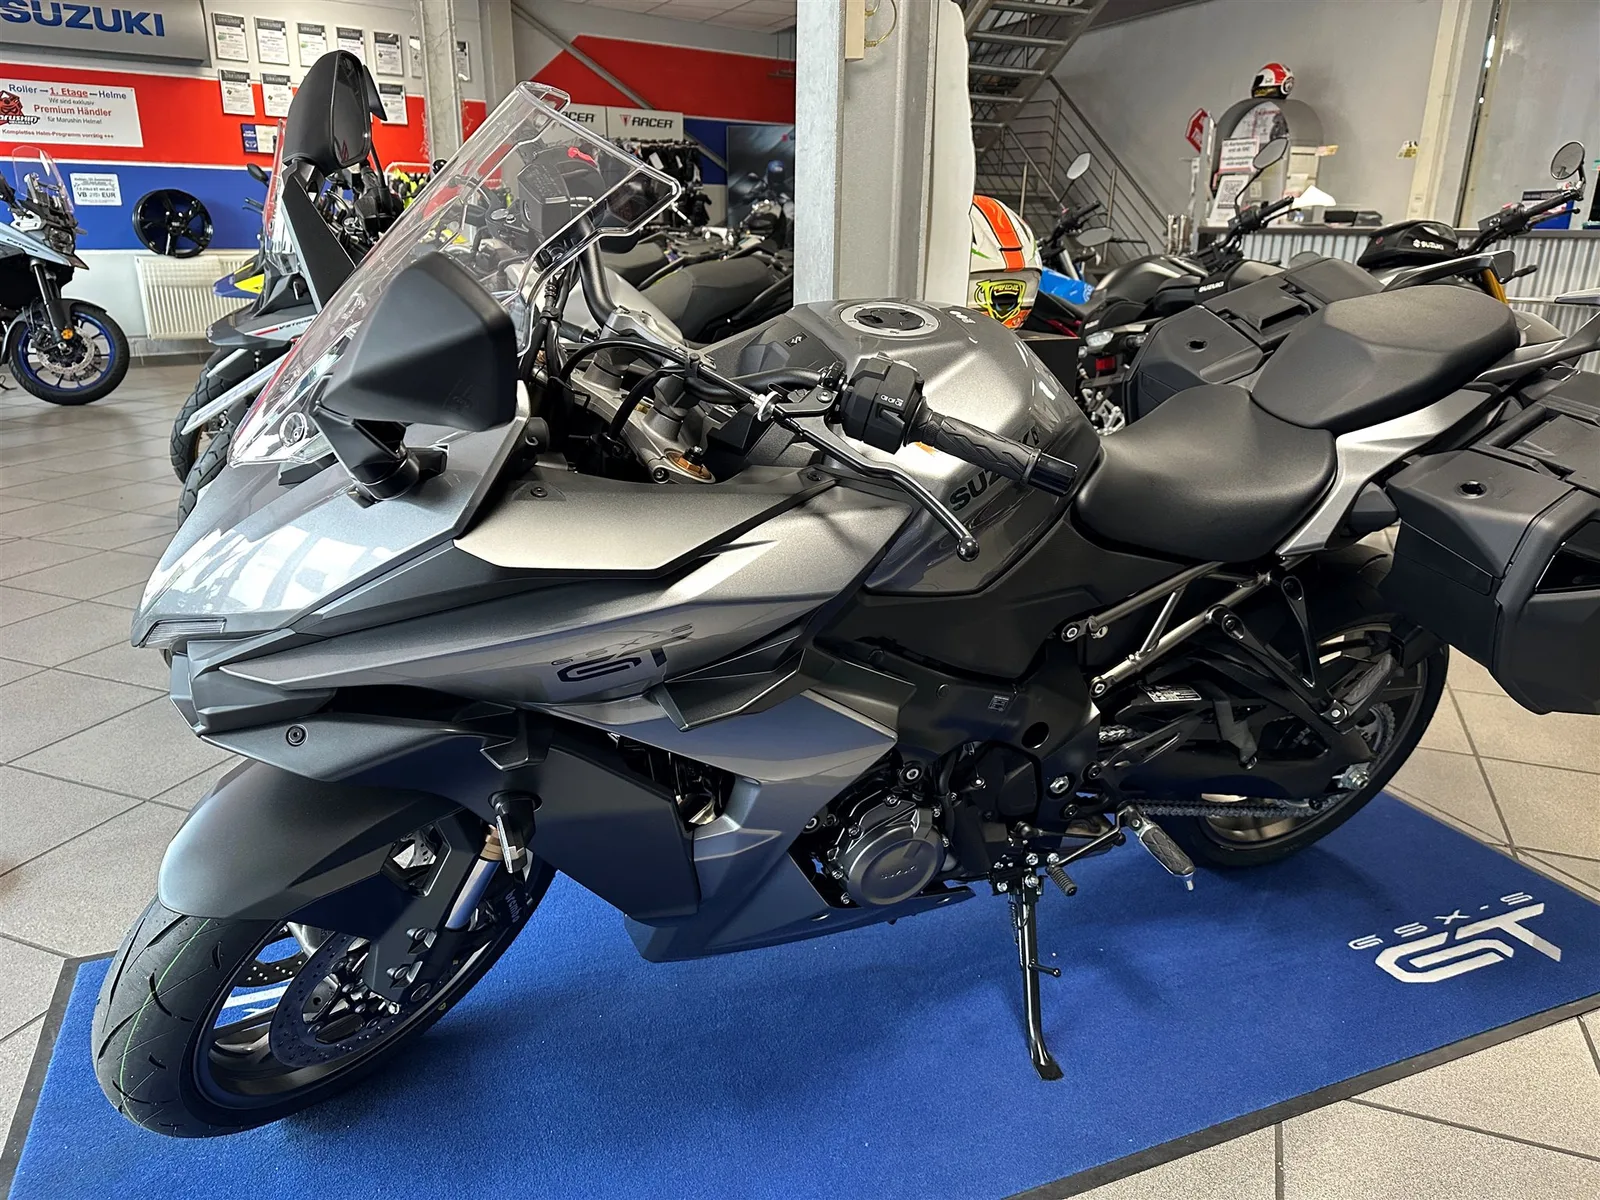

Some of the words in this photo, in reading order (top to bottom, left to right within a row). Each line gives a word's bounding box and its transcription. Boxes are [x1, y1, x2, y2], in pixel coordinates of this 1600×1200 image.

[0, 0, 165, 37] SUZUKI
[9, 83, 37, 94] Roller
[61, 87, 88, 98] Etage
[98, 90, 127, 100] Helme
[33, 104, 75, 114] Premium
[77, 106, 112, 117] Händler
[561, 111, 595, 123] ACER
[632, 116, 673, 128] RACER
[1348, 891, 1533, 950] GSX-S
[1375, 902, 1562, 983] GT
